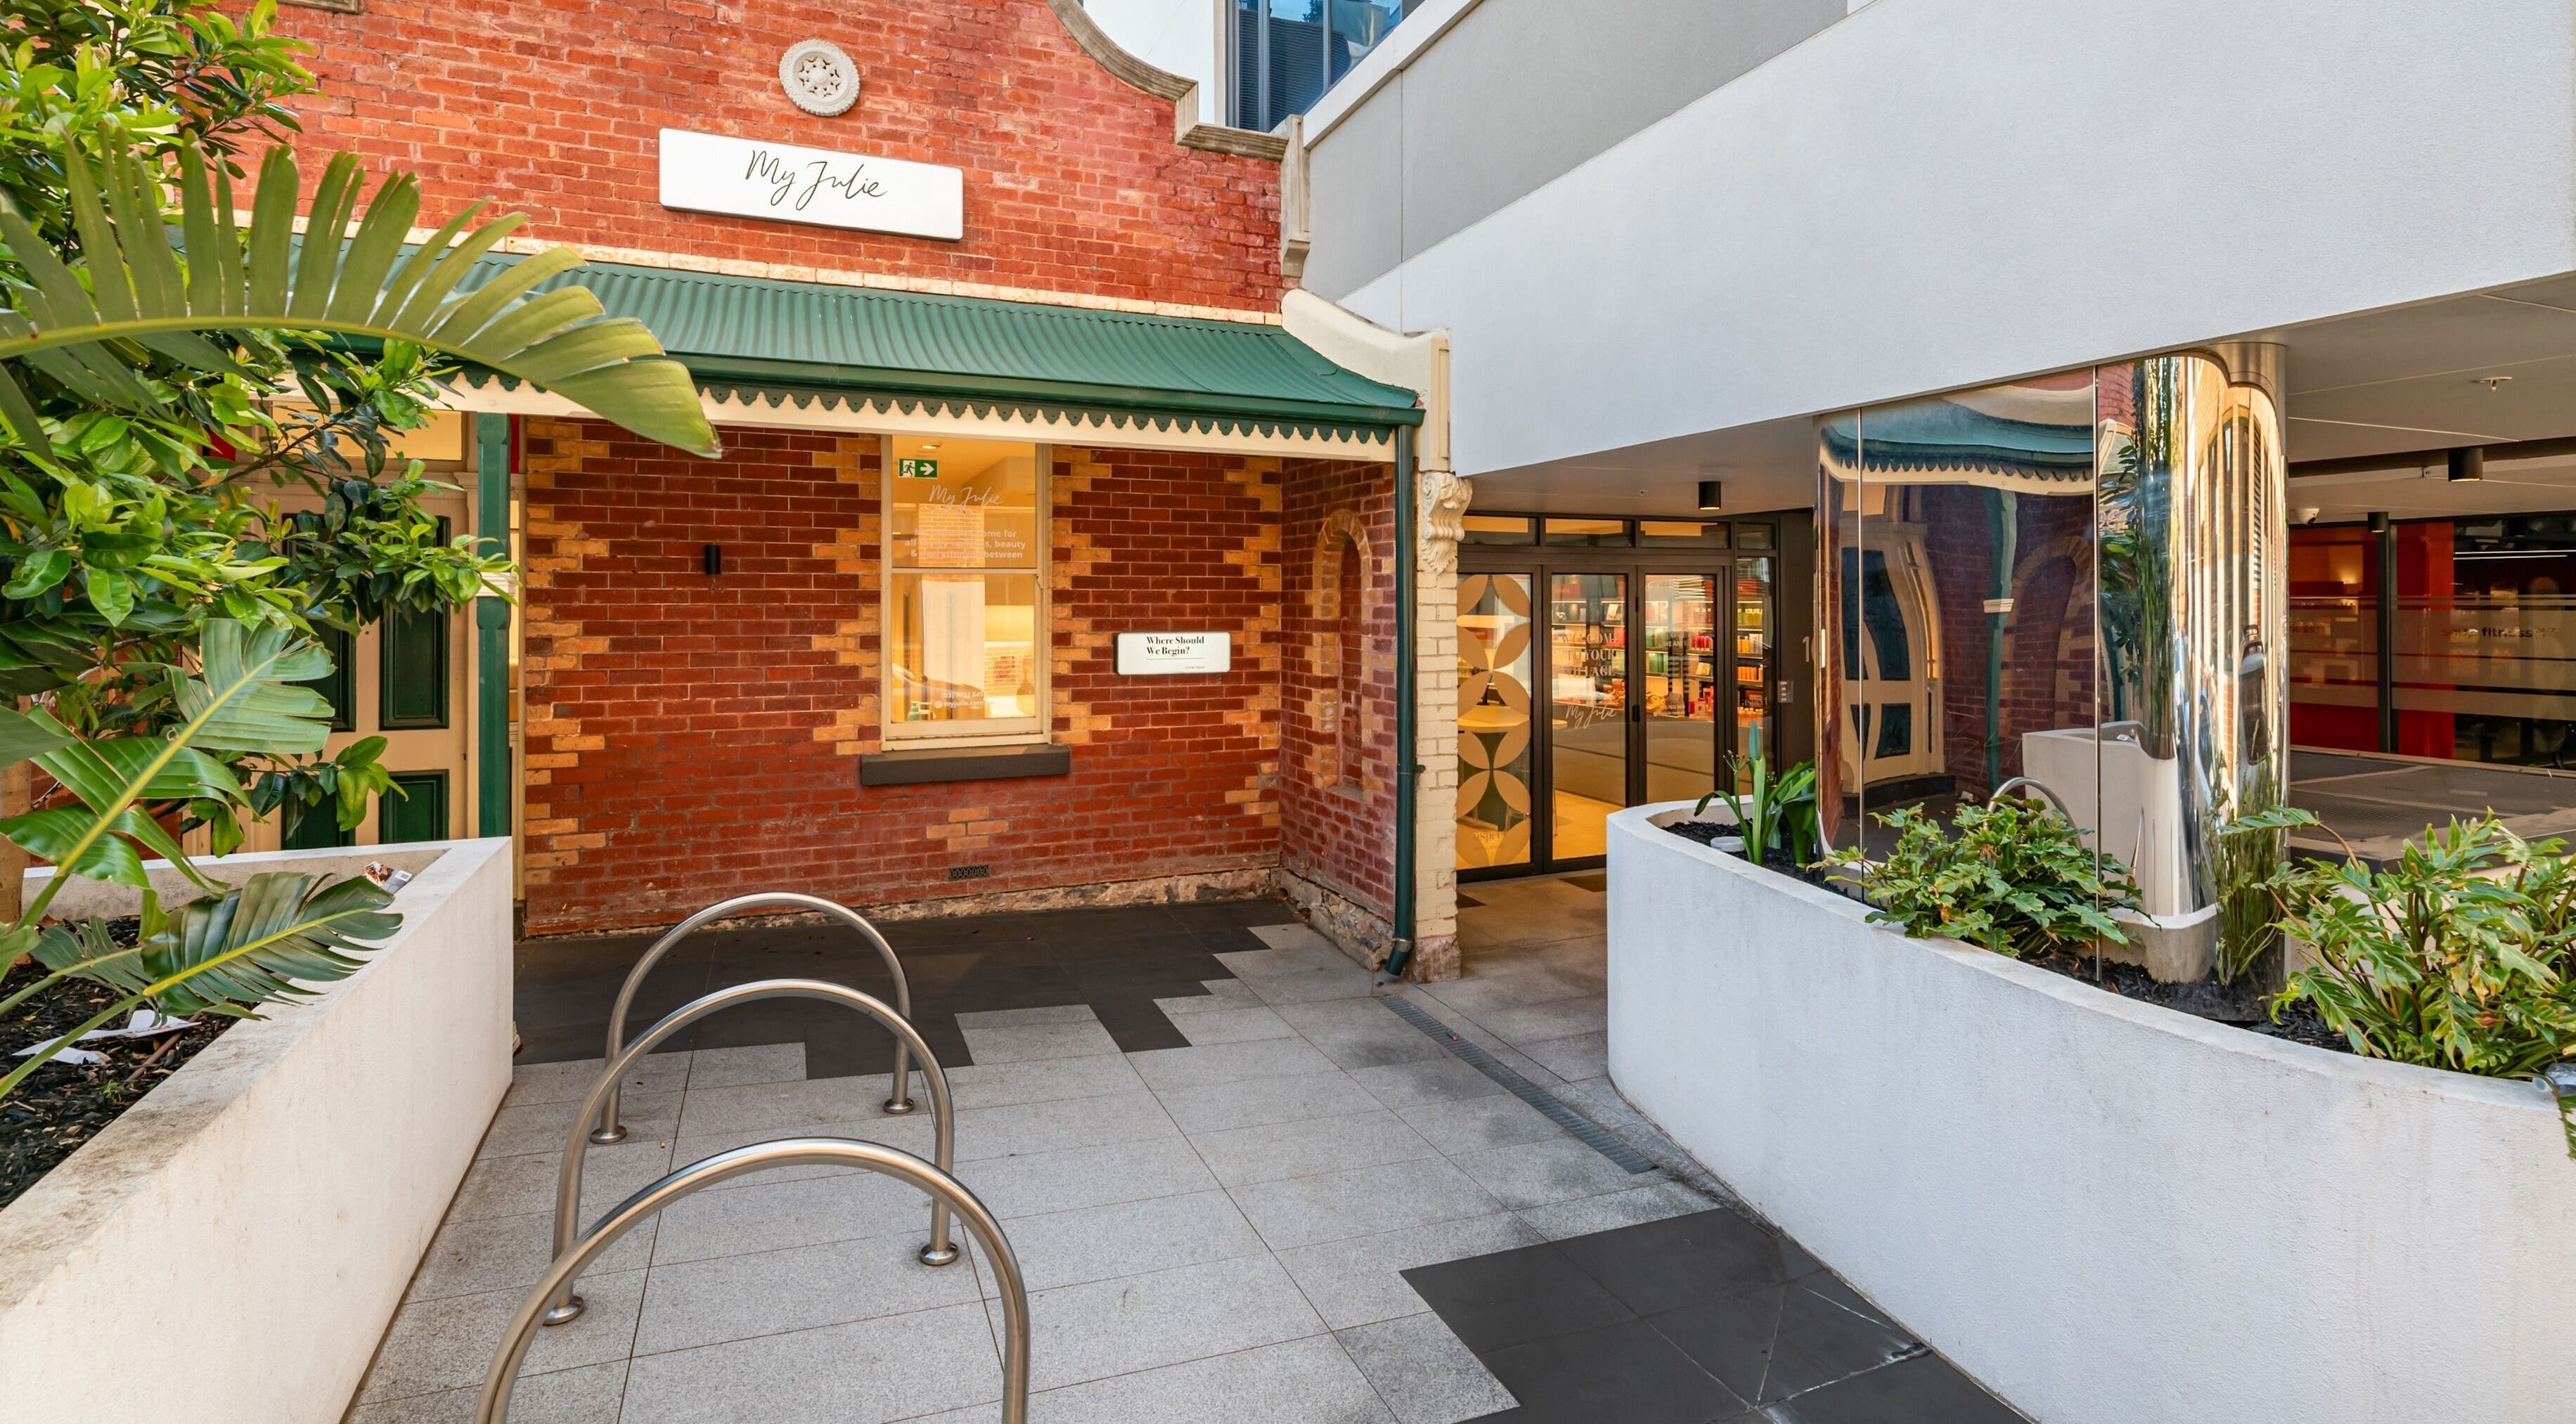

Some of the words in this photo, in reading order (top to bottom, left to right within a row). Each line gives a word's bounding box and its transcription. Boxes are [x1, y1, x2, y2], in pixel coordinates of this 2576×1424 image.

[745, 149, 797, 207] My
[795, 160, 889, 212] Julie
[929, 484, 957, 507] My
[954, 486, 1005, 510] Julie
[995, 540, 1026, 549] beauty
[1146, 636, 1174, 645] Where
[1176, 635, 1204, 645] Should
[2481, 626, 2533, 638] fitness
[1161, 646, 1190, 656] Begin?
[1801, 635, 1815, 663] 1
[1565, 704, 1585, 730] My
[1583, 704, 1617, 729] Julie
